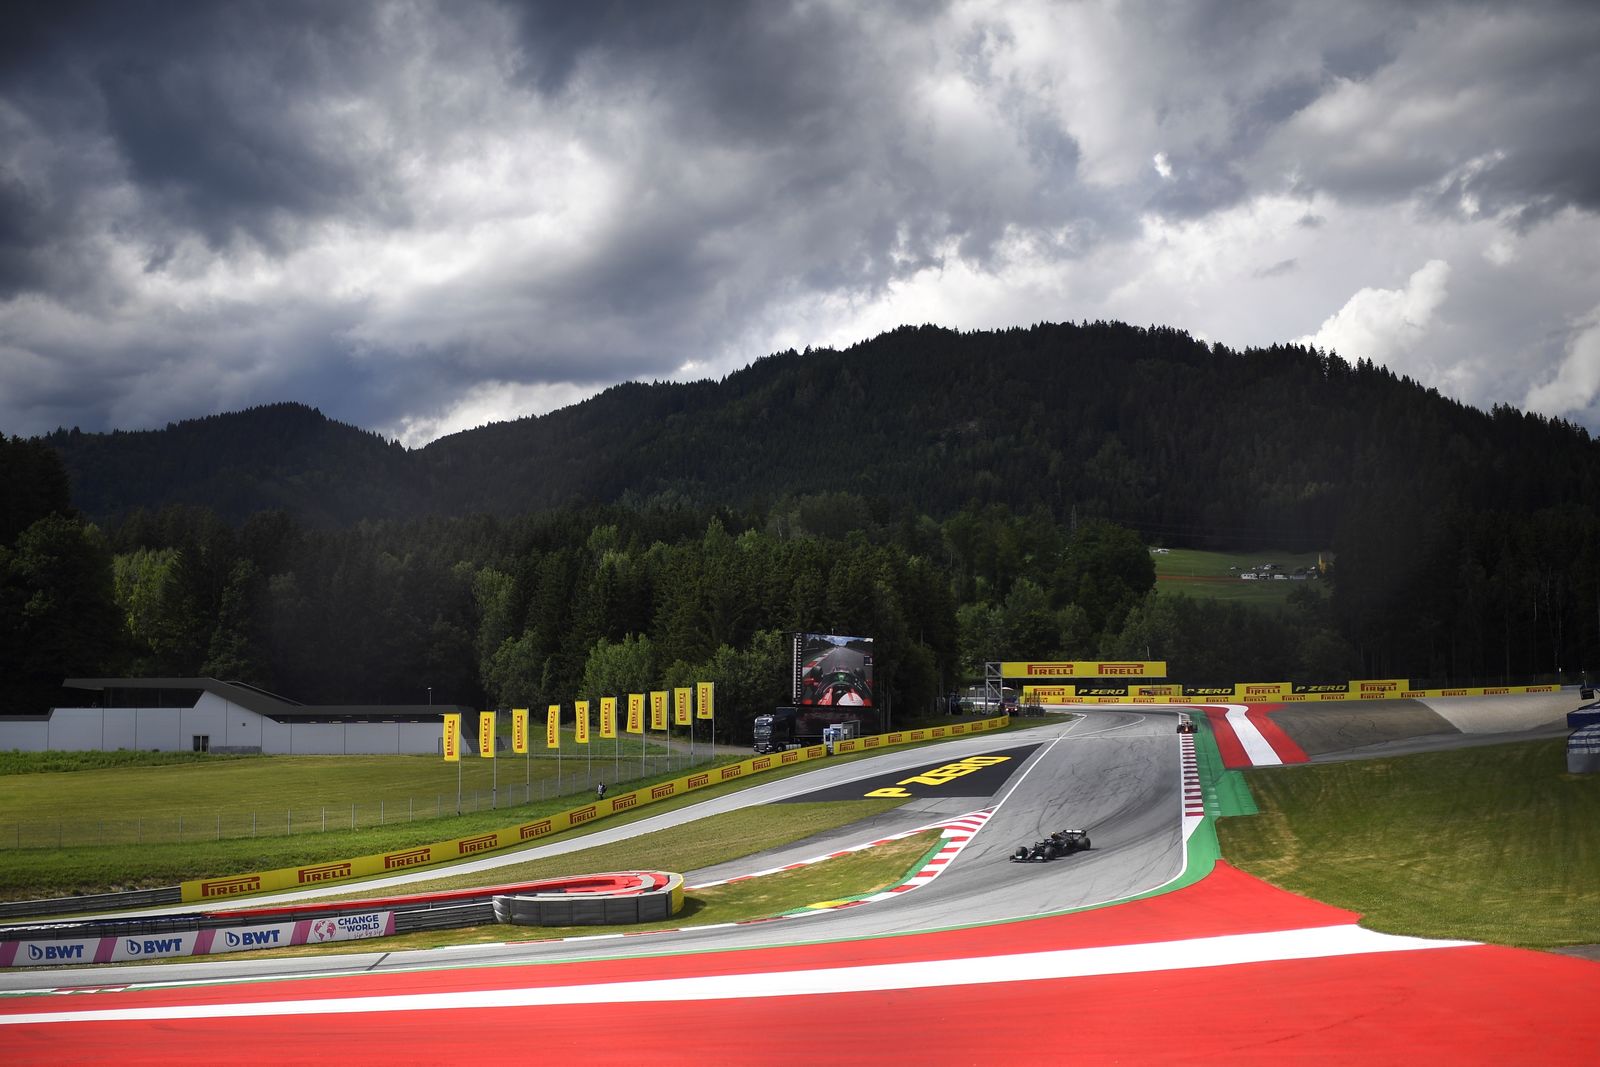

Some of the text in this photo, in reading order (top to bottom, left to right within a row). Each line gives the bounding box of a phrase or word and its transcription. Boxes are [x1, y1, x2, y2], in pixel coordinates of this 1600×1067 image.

[1028, 664, 1074, 675] PIRELLI
[1098, 664, 1144, 675] PIRELLI
[840, 741, 855, 752] PIRELLI
[752, 758, 771, 770] PIRELLI
[782, 752, 798, 764] PIRELLI
[722, 764, 741, 780] PIRELLI
[864, 756, 1012, 798] P ZERO
[688, 774, 708, 789] PIRELLI
[652, 783, 674, 800] PIRELLI
[612, 794, 636, 811] PIRELLI
[570, 806, 596, 824] PIRELLI
[520, 820, 551, 840] PIRELLI
[459, 834, 498, 854] PIRELLI
[384, 848, 430, 869] PIRELLI
[298, 863, 351, 884] PIRELLI
[202, 876, 260, 897] PIRELLI
[338, 914, 378, 926] CHANGE
[346, 922, 380, 932] WORLD
[242, 929, 280, 946] BWT
[46, 944, 84, 960] BWT
[144, 938, 182, 954] BWT
